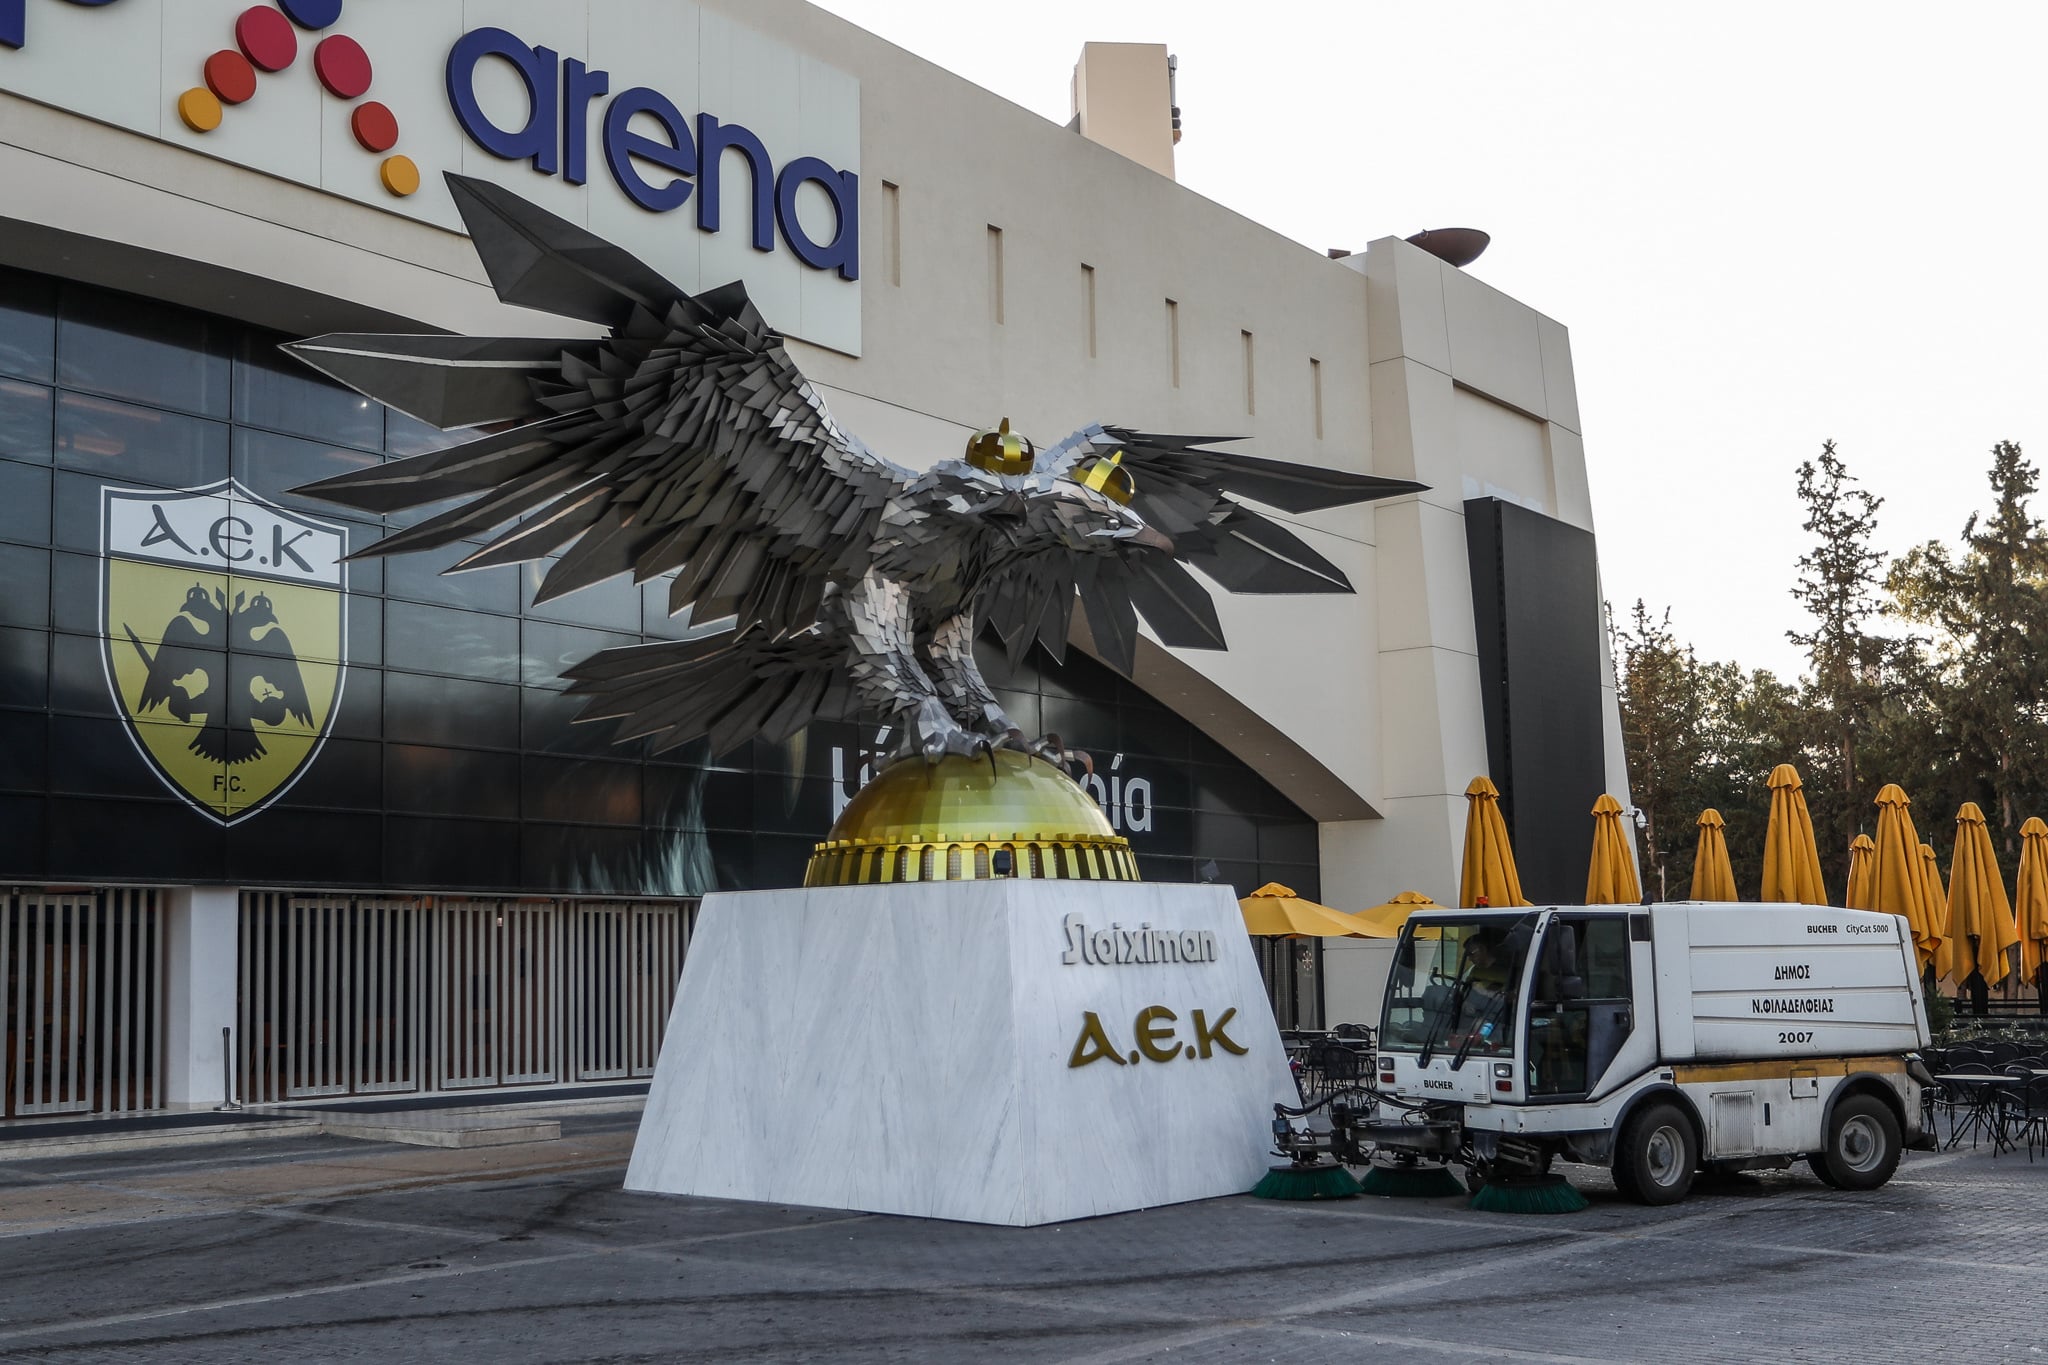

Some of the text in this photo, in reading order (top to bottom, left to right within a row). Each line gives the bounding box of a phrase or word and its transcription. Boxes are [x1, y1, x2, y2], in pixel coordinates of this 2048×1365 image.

[446, 27, 859, 281] arena
[1807, 924, 1889, 936] BUCHER CityCat 5000
[1063, 912, 1218, 965] Stoiximan
[1775, 965, 1811, 980] ΔΗΜΟΣ
[1752, 998, 1834, 1014] Ν.ΦΙΛΑΔΕΛΦΕΙΑΣ
[1778, 1032, 1814, 1044] 2007
[1423, 1079, 1454, 1091] BUCHER
